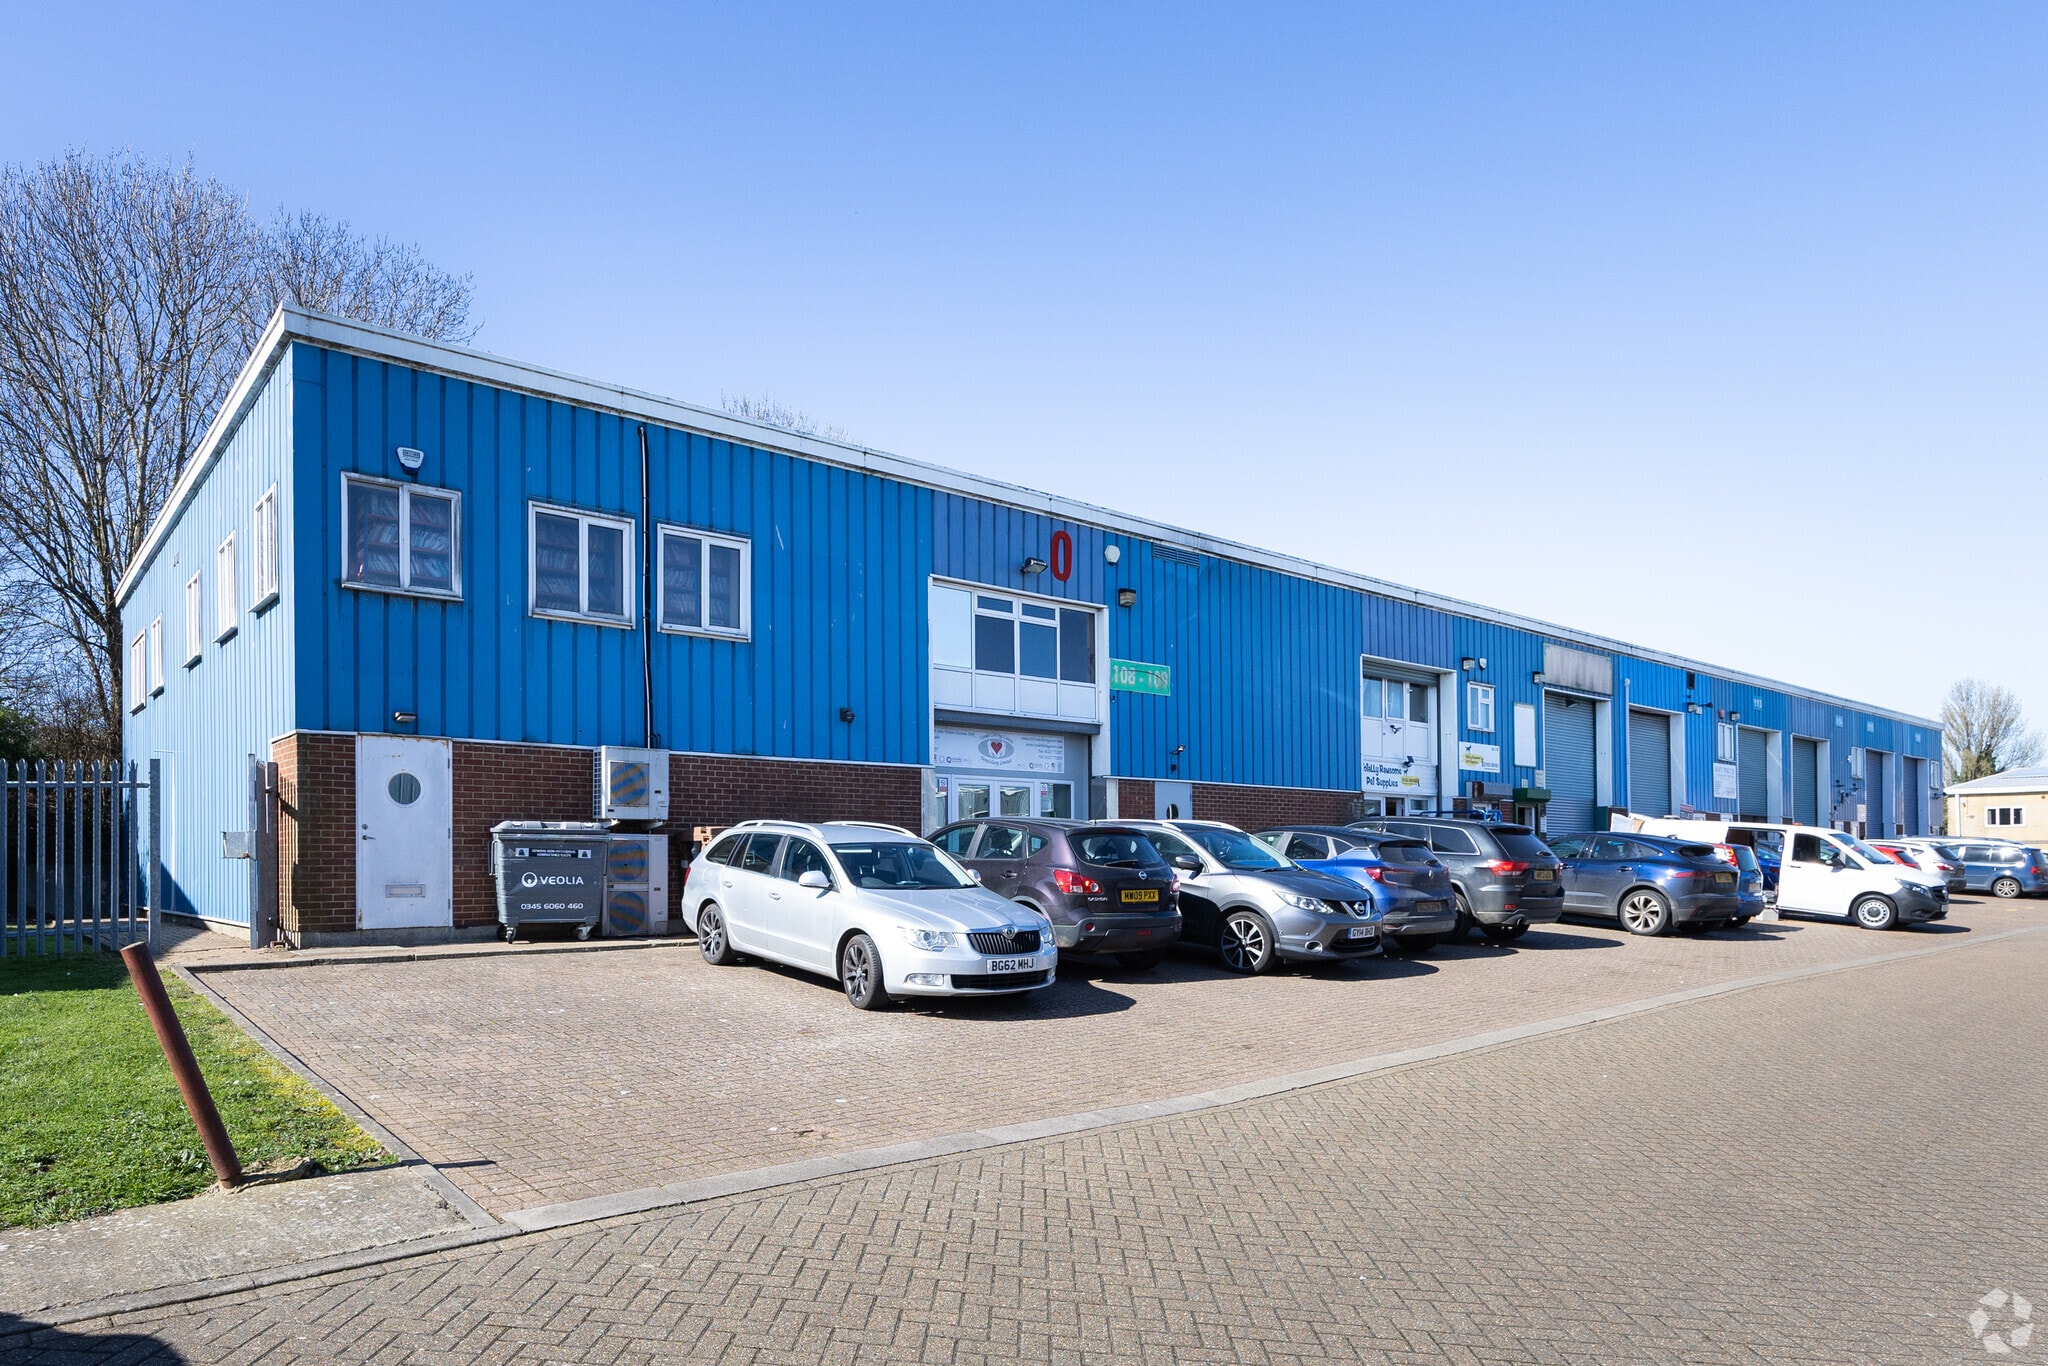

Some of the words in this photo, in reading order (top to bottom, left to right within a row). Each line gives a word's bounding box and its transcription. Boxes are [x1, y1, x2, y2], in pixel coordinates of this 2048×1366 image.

[1113, 665, 1136, 686] 108
[1363, 763, 1379, 776] otally
[1366, 776, 1375, 786] Pet
[1376, 776, 1398, 789] Supplies
[540, 876, 584, 885] VEOLIA
[1124, 891, 1142, 900] MW09
[544, 902, 565, 910] 6060
[567, 902, 584, 910] 460
[991, 960, 1016, 971] BG62
[1018, 957, 1034, 969] MHJ
